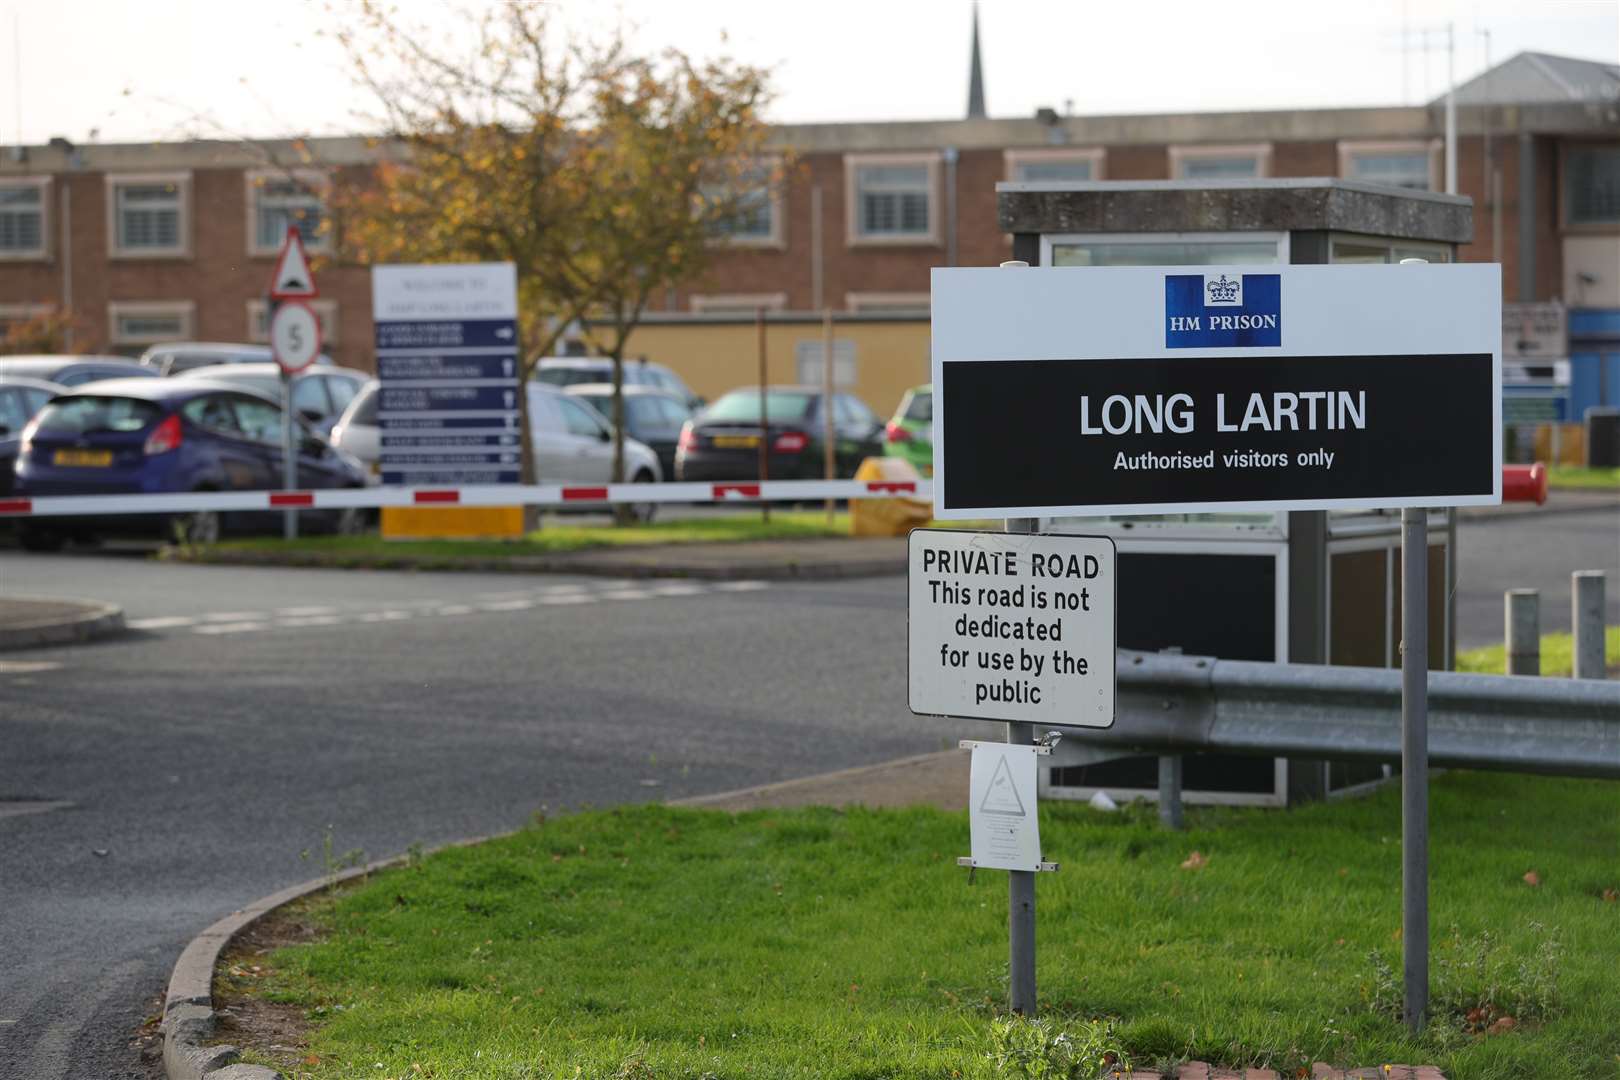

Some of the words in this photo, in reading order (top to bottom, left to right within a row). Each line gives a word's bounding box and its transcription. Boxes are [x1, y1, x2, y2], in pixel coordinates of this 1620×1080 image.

[288, 325, 301, 351] 5
[1170, 316, 1201, 332] HM
[1209, 314, 1276, 331] PRISON
[1080, 393, 1194, 435] LONG
[1216, 390, 1366, 432] LARTIN
[1113, 450, 1214, 470] Authorised
[1222, 450, 1289, 469] visitors
[1297, 447, 1335, 470] only
[923, 548, 1018, 576] PRIVATE
[1031, 553, 1099, 579] ROAD
[928, 579, 971, 606] This
[978, 584, 1025, 608] road
[1031, 584, 1048, 610] is
[1054, 587, 1090, 612] not
[954, 612, 1062, 642] dedicated
[940, 643, 970, 668] for
[977, 651, 1015, 671] use
[1020, 647, 1045, 678] by
[1052, 649, 1089, 676] the
[975, 678, 1042, 706] public
